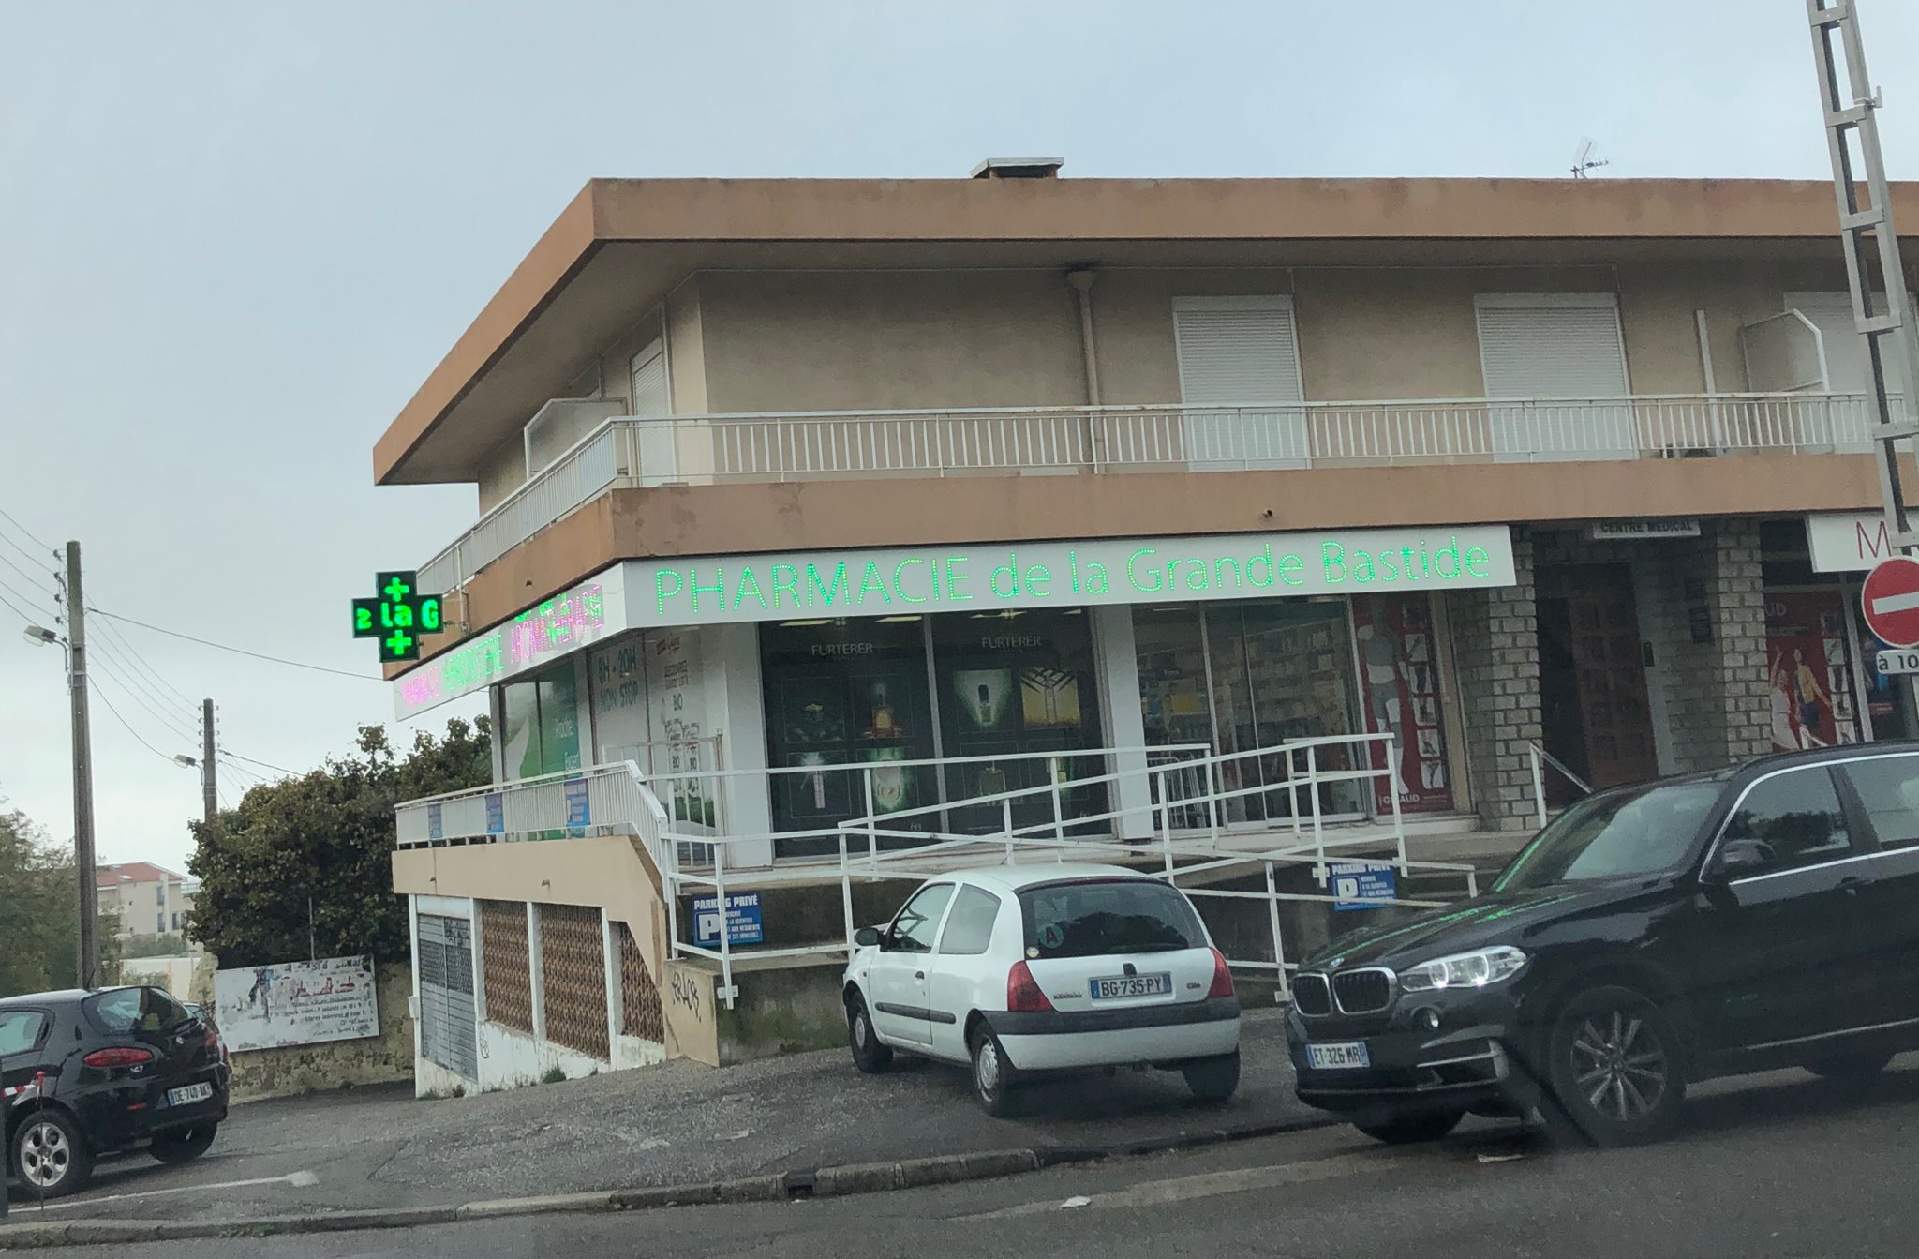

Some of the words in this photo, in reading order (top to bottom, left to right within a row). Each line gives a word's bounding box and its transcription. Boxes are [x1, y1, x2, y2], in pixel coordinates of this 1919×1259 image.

[655, 555, 974, 615] PHARMACIE
[990, 551, 1053, 600] de
[1070, 549, 1110, 595] la
[1126, 544, 1304, 594] Grande
[1320, 536, 1490, 585] Bastide
[381, 602, 413, 628] la
[421, 598, 440, 630] G
[811, 642, 873, 657] FURTERER
[981, 635, 1041, 649] FURTERER
[1878, 656, 1889, 671] à
[699, 913, 722, 940] P
[1101, 978, 1162, 997] BG-735-PY
